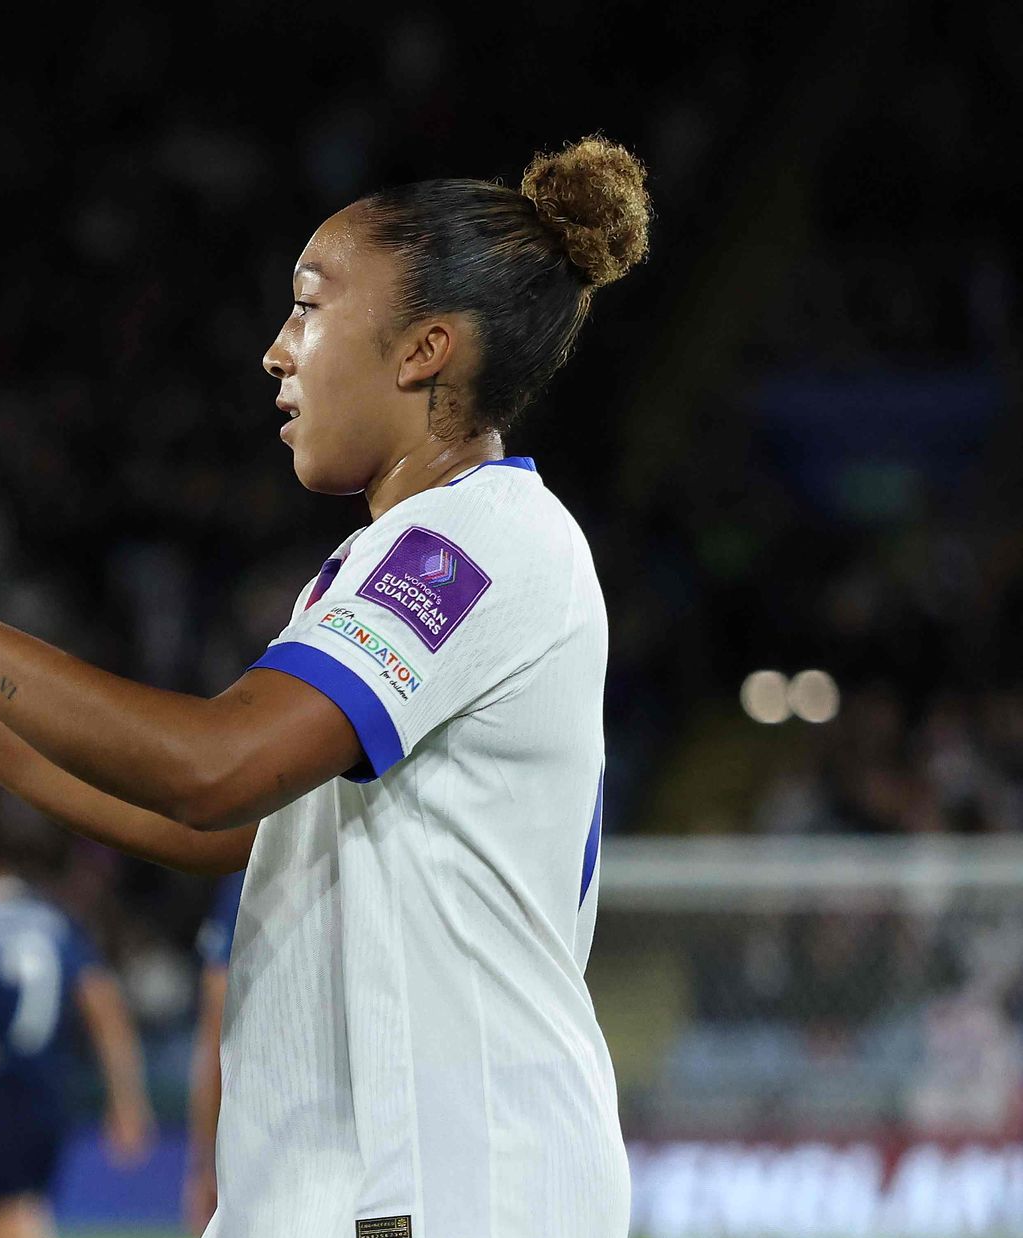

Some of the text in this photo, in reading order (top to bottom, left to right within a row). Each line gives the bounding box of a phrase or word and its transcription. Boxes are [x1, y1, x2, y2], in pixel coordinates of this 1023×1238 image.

[374, 581, 442, 636] QUALIFIERS
[381, 573, 448, 626] EUROPEAN
[404, 573, 442, 605] women's
[330, 607, 355, 620] UEFA
[320, 613, 420, 693] FOUNDATION
[379, 670, 409, 702] for children
